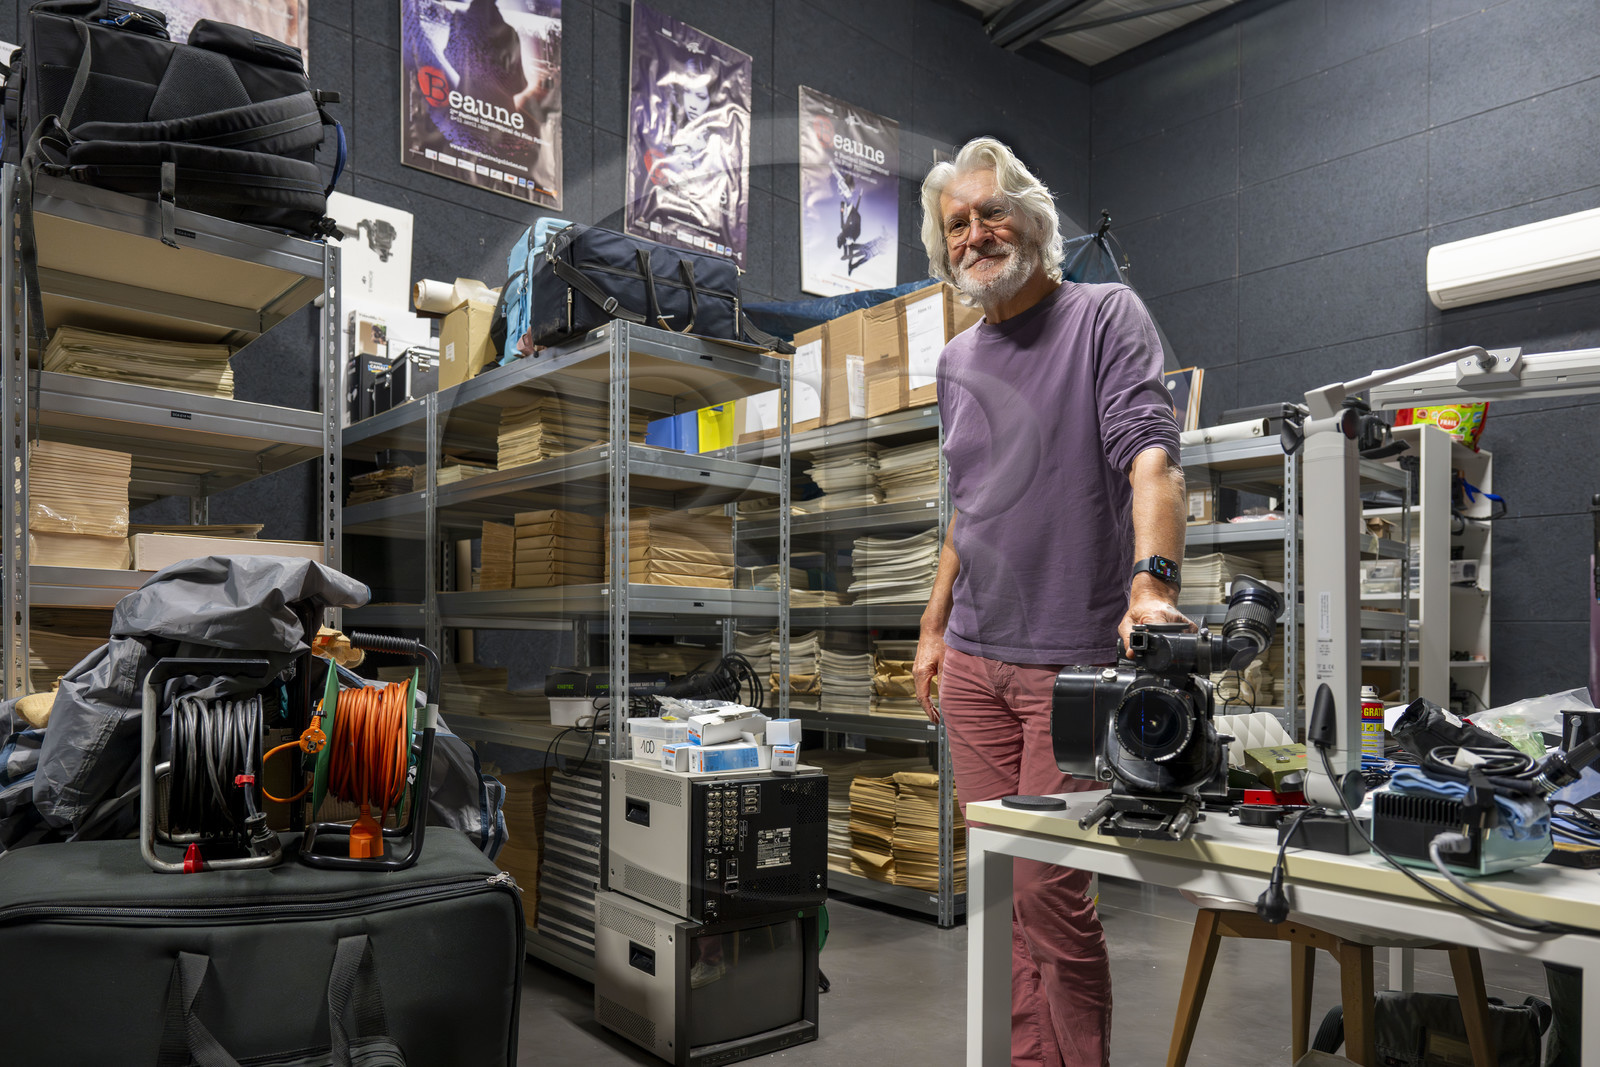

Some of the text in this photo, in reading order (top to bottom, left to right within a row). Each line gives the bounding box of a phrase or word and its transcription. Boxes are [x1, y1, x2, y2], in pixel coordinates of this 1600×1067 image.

[425, 72, 524, 129] Beaune
[1440, 419, 1457, 427] FRAIS
[640, 740, 655, 754] 100
